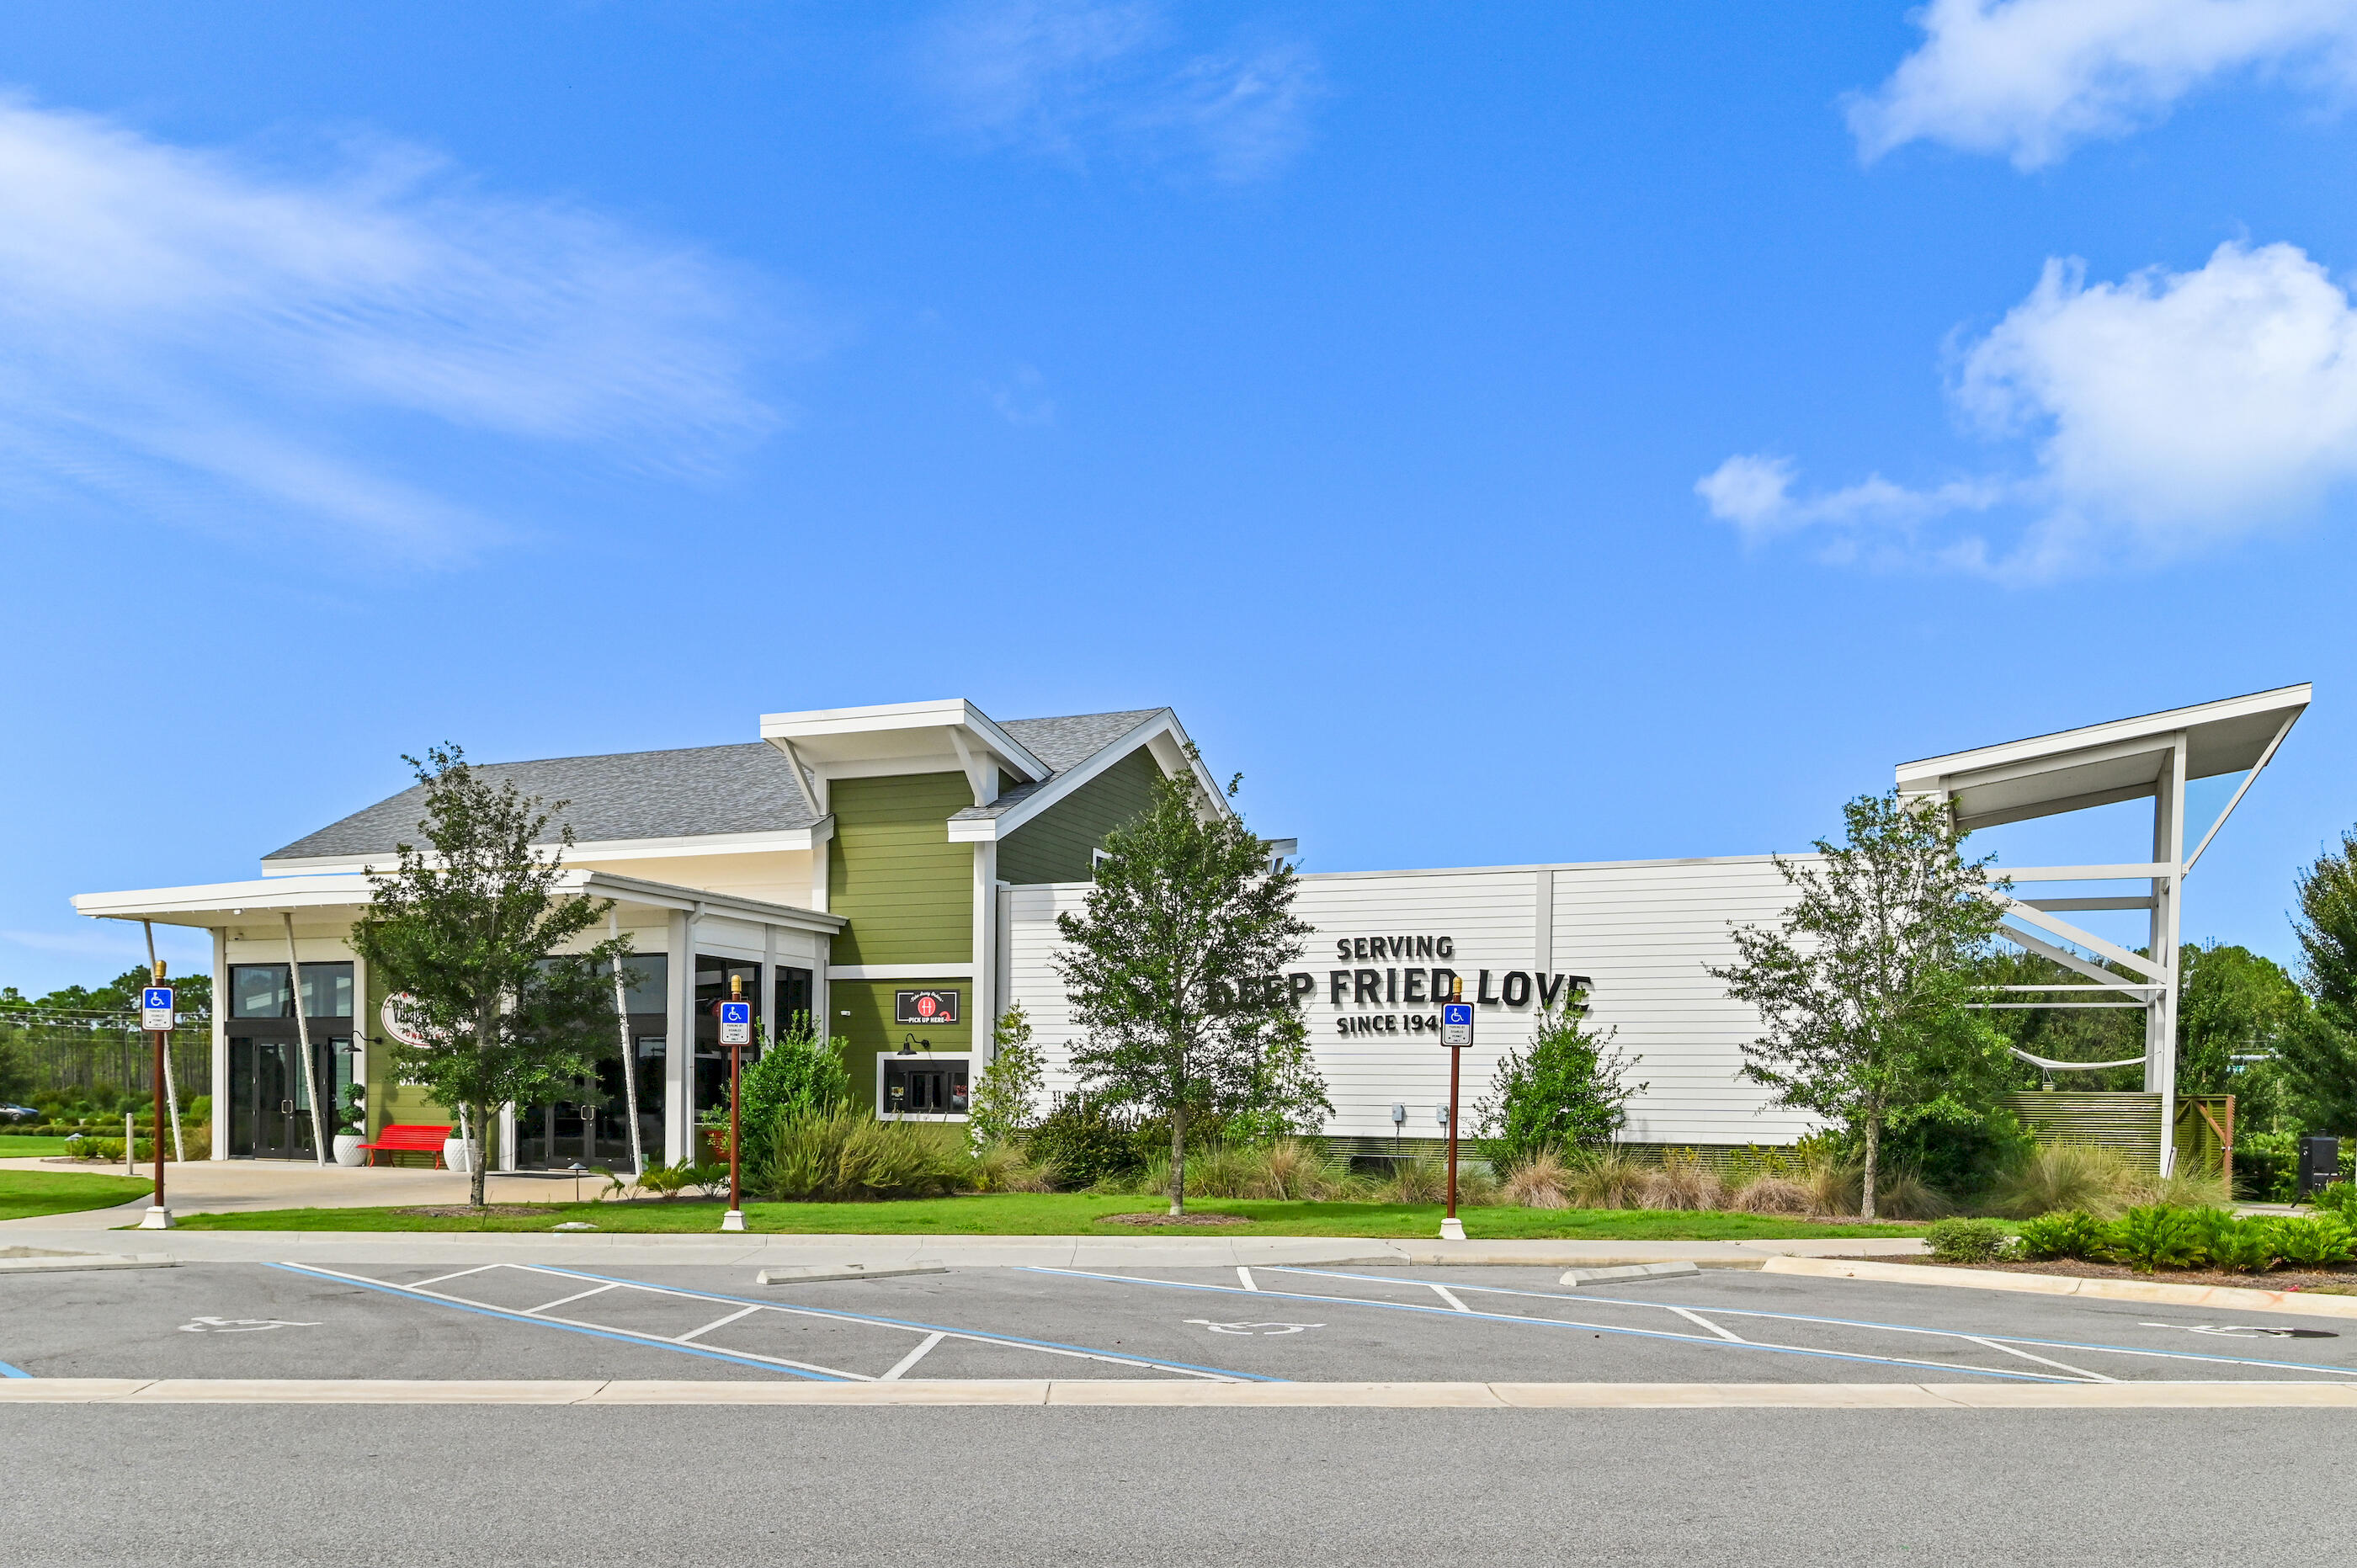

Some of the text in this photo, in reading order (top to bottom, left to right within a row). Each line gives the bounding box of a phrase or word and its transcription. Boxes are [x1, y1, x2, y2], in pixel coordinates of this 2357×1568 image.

[1337, 936, 1454, 959] SERVING
[1329, 967, 1460, 1004] FRIED
[1476, 969, 1592, 1013] LOVE
[1336, 1014, 1441, 1034] SINCE 194
